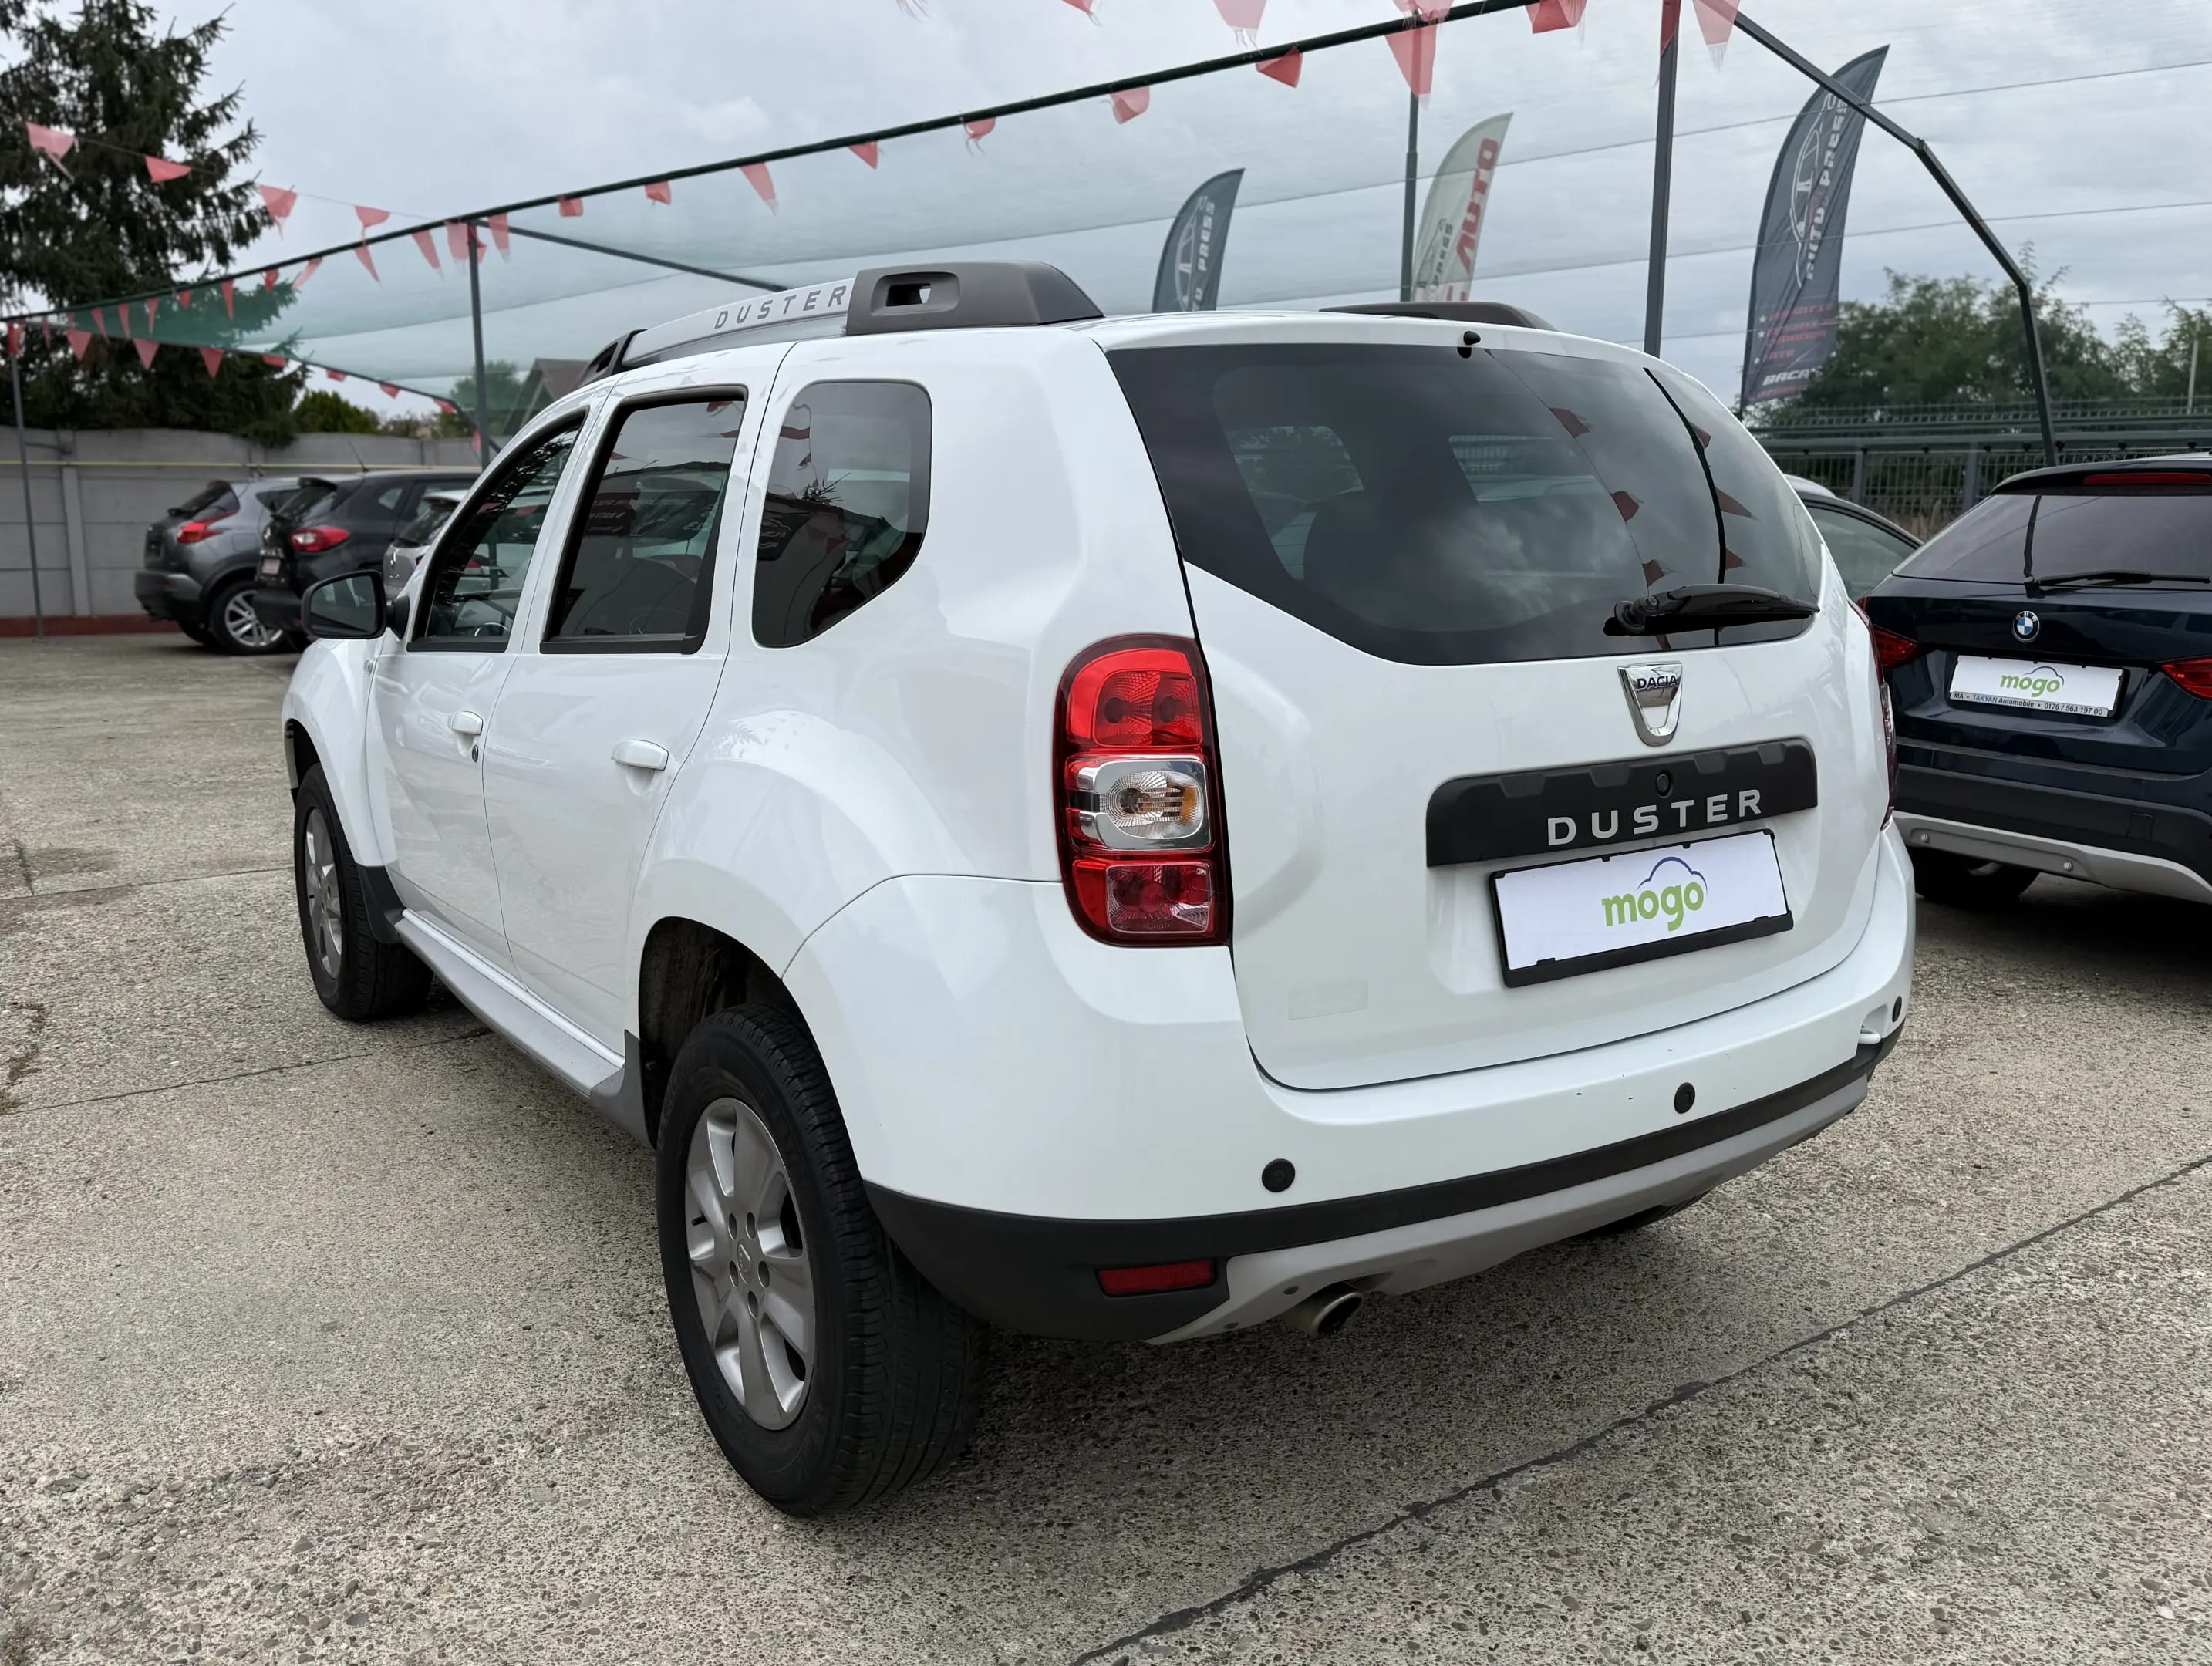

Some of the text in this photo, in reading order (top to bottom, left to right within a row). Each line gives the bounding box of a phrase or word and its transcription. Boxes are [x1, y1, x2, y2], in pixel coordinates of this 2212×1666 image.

[1456, 137, 1499, 275] AUTO
[1198, 201, 1216, 272] PRESS
[714, 285, 847, 329] DUSTER
[1762, 369, 1812, 386] BACA
[1637, 675, 1678, 689] DACIA
[1973, 694, 1998, 703] TAKYAN
[1998, 698, 2035, 707] Automobile
[2000, 674, 2060, 698] mogo
[1547, 789, 1762, 846] DUSTER
[1601, 882, 1705, 931] mogo
